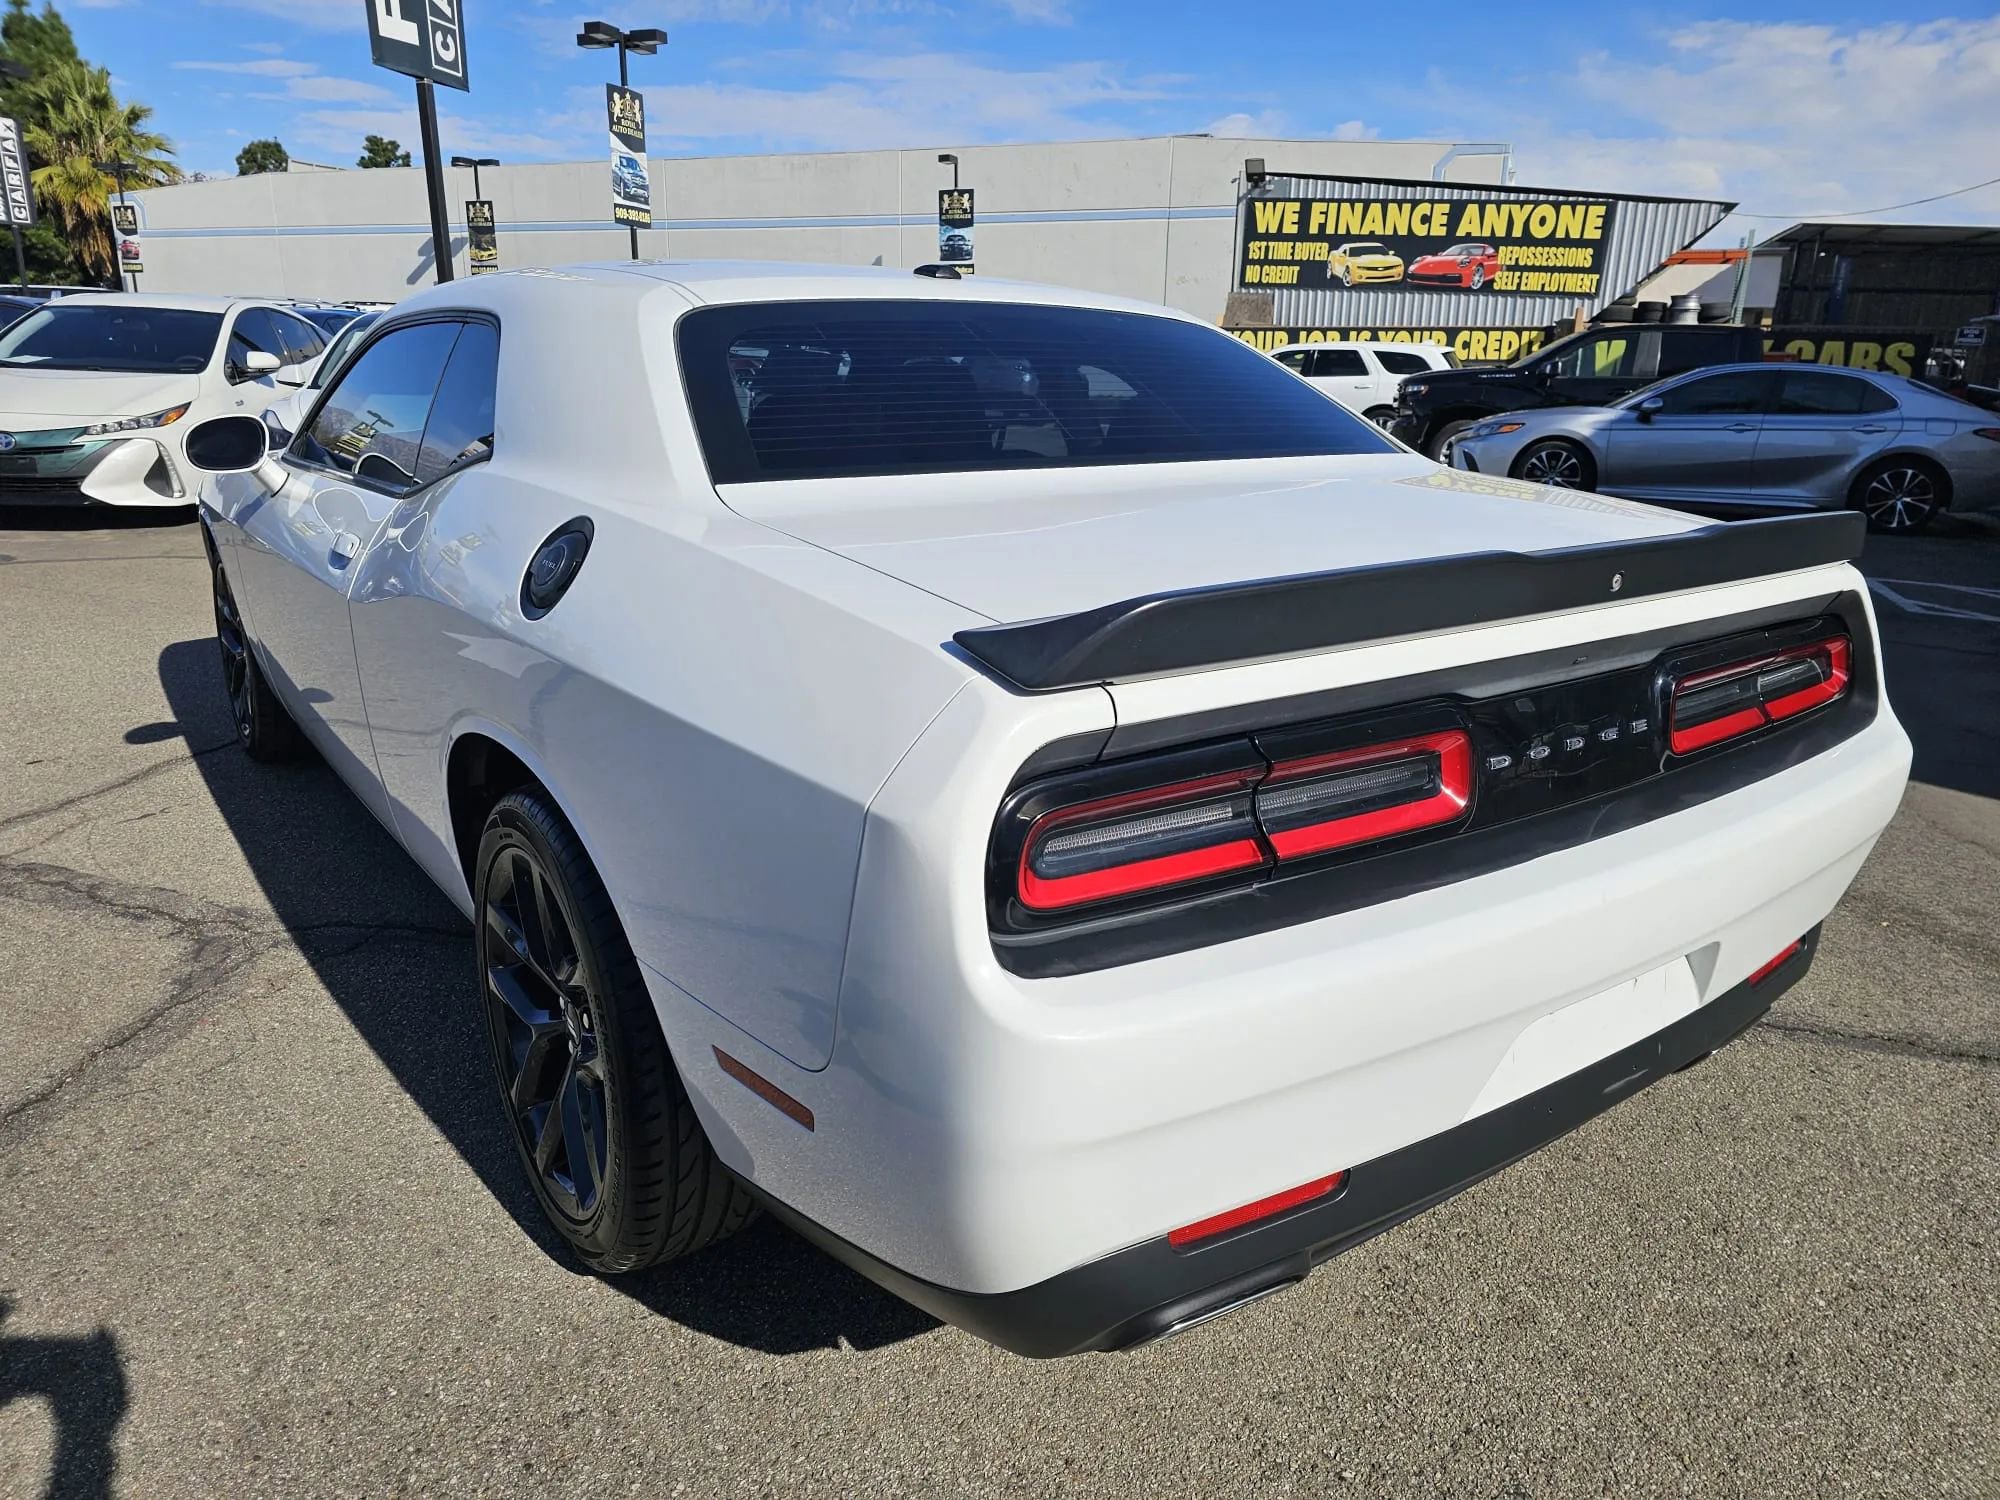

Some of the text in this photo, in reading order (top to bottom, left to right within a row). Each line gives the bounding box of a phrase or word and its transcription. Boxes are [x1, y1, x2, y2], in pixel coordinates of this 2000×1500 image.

[1255, 202, 1607, 239] WE FINANCE ANYONE
[1248, 241, 1329, 261] 1ST TIME BUYER
[1497, 246, 1593, 268] REPOSSESSIONS
[1245, 265, 1300, 284] NO CREDIT
[1493, 271, 1600, 294] SELF EMPLOYMENT
[1454, 330, 1545, 360] CREDIT
[1487, 718, 1649, 770] DODGE
